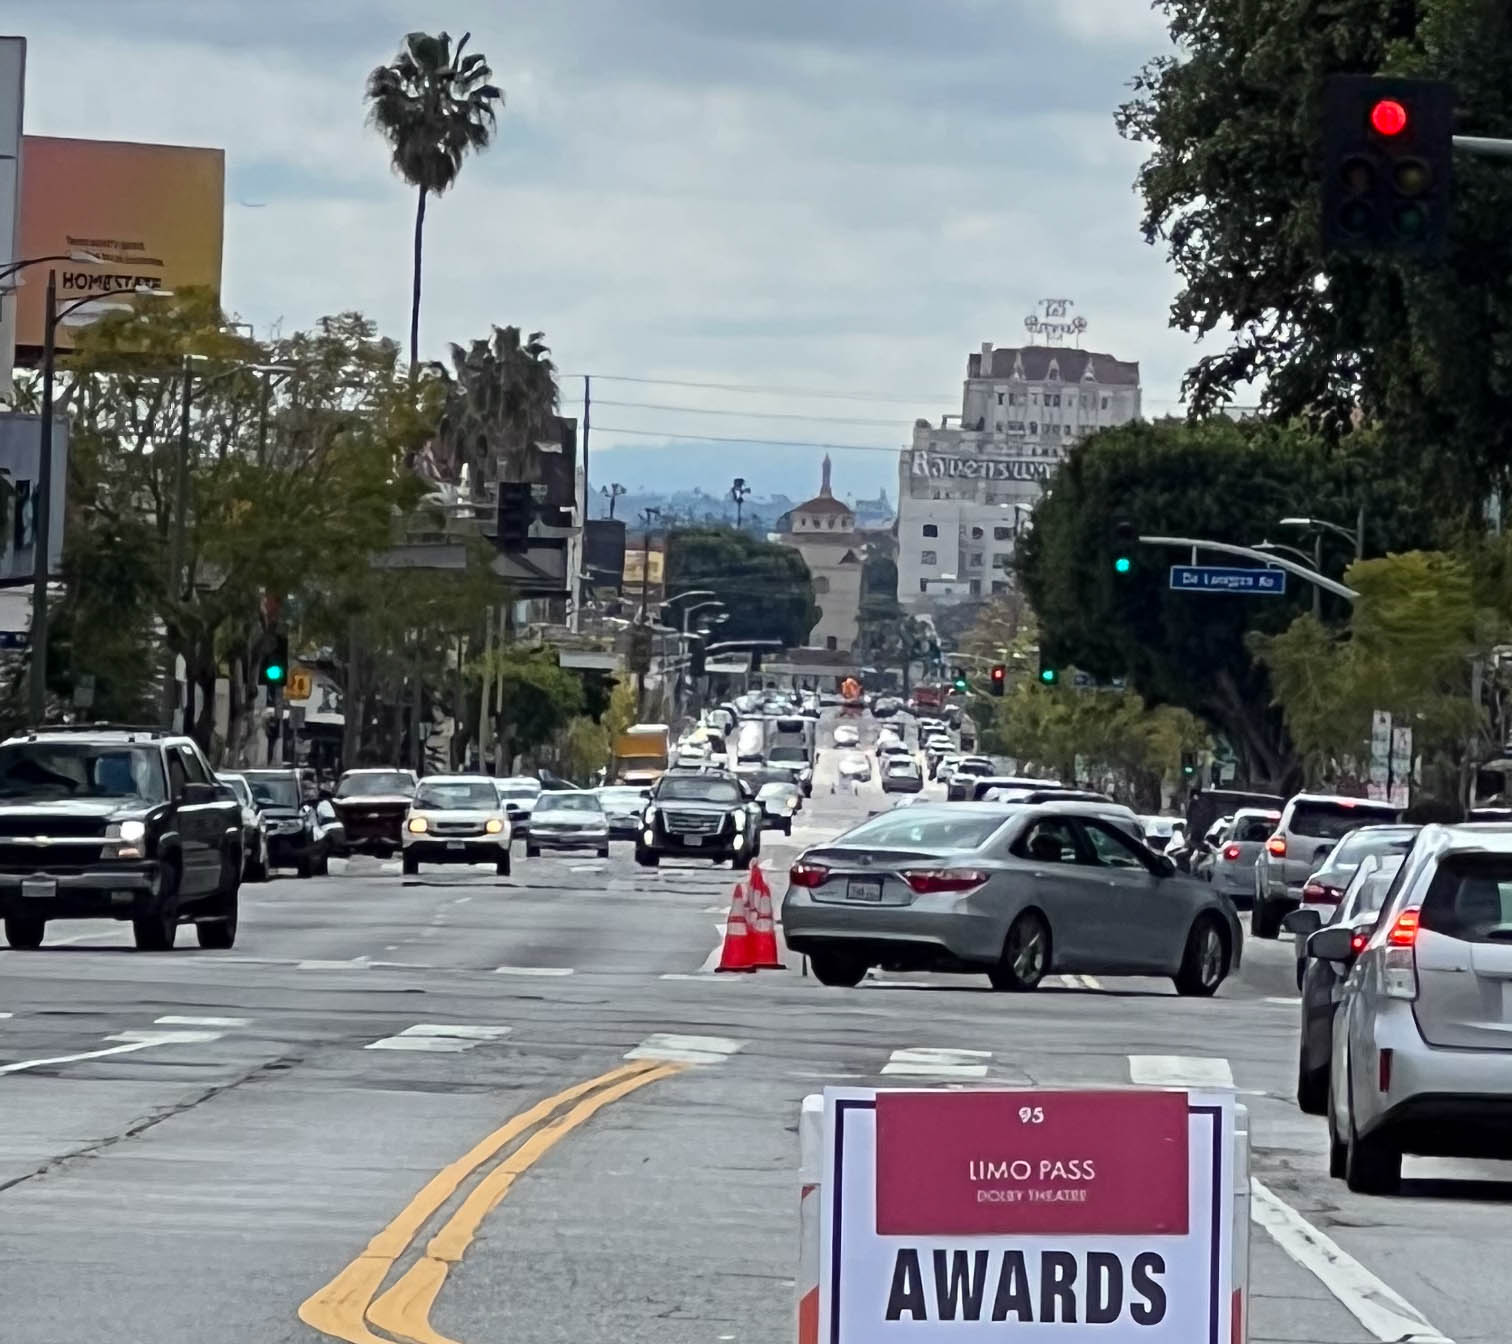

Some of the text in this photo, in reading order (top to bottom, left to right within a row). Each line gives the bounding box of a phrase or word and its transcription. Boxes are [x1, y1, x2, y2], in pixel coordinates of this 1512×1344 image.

[1018, 1106, 1045, 1124] 95
[969, 1160, 1096, 1180] LIMO PASS
[884, 1248, 1168, 1325] AWARDS
